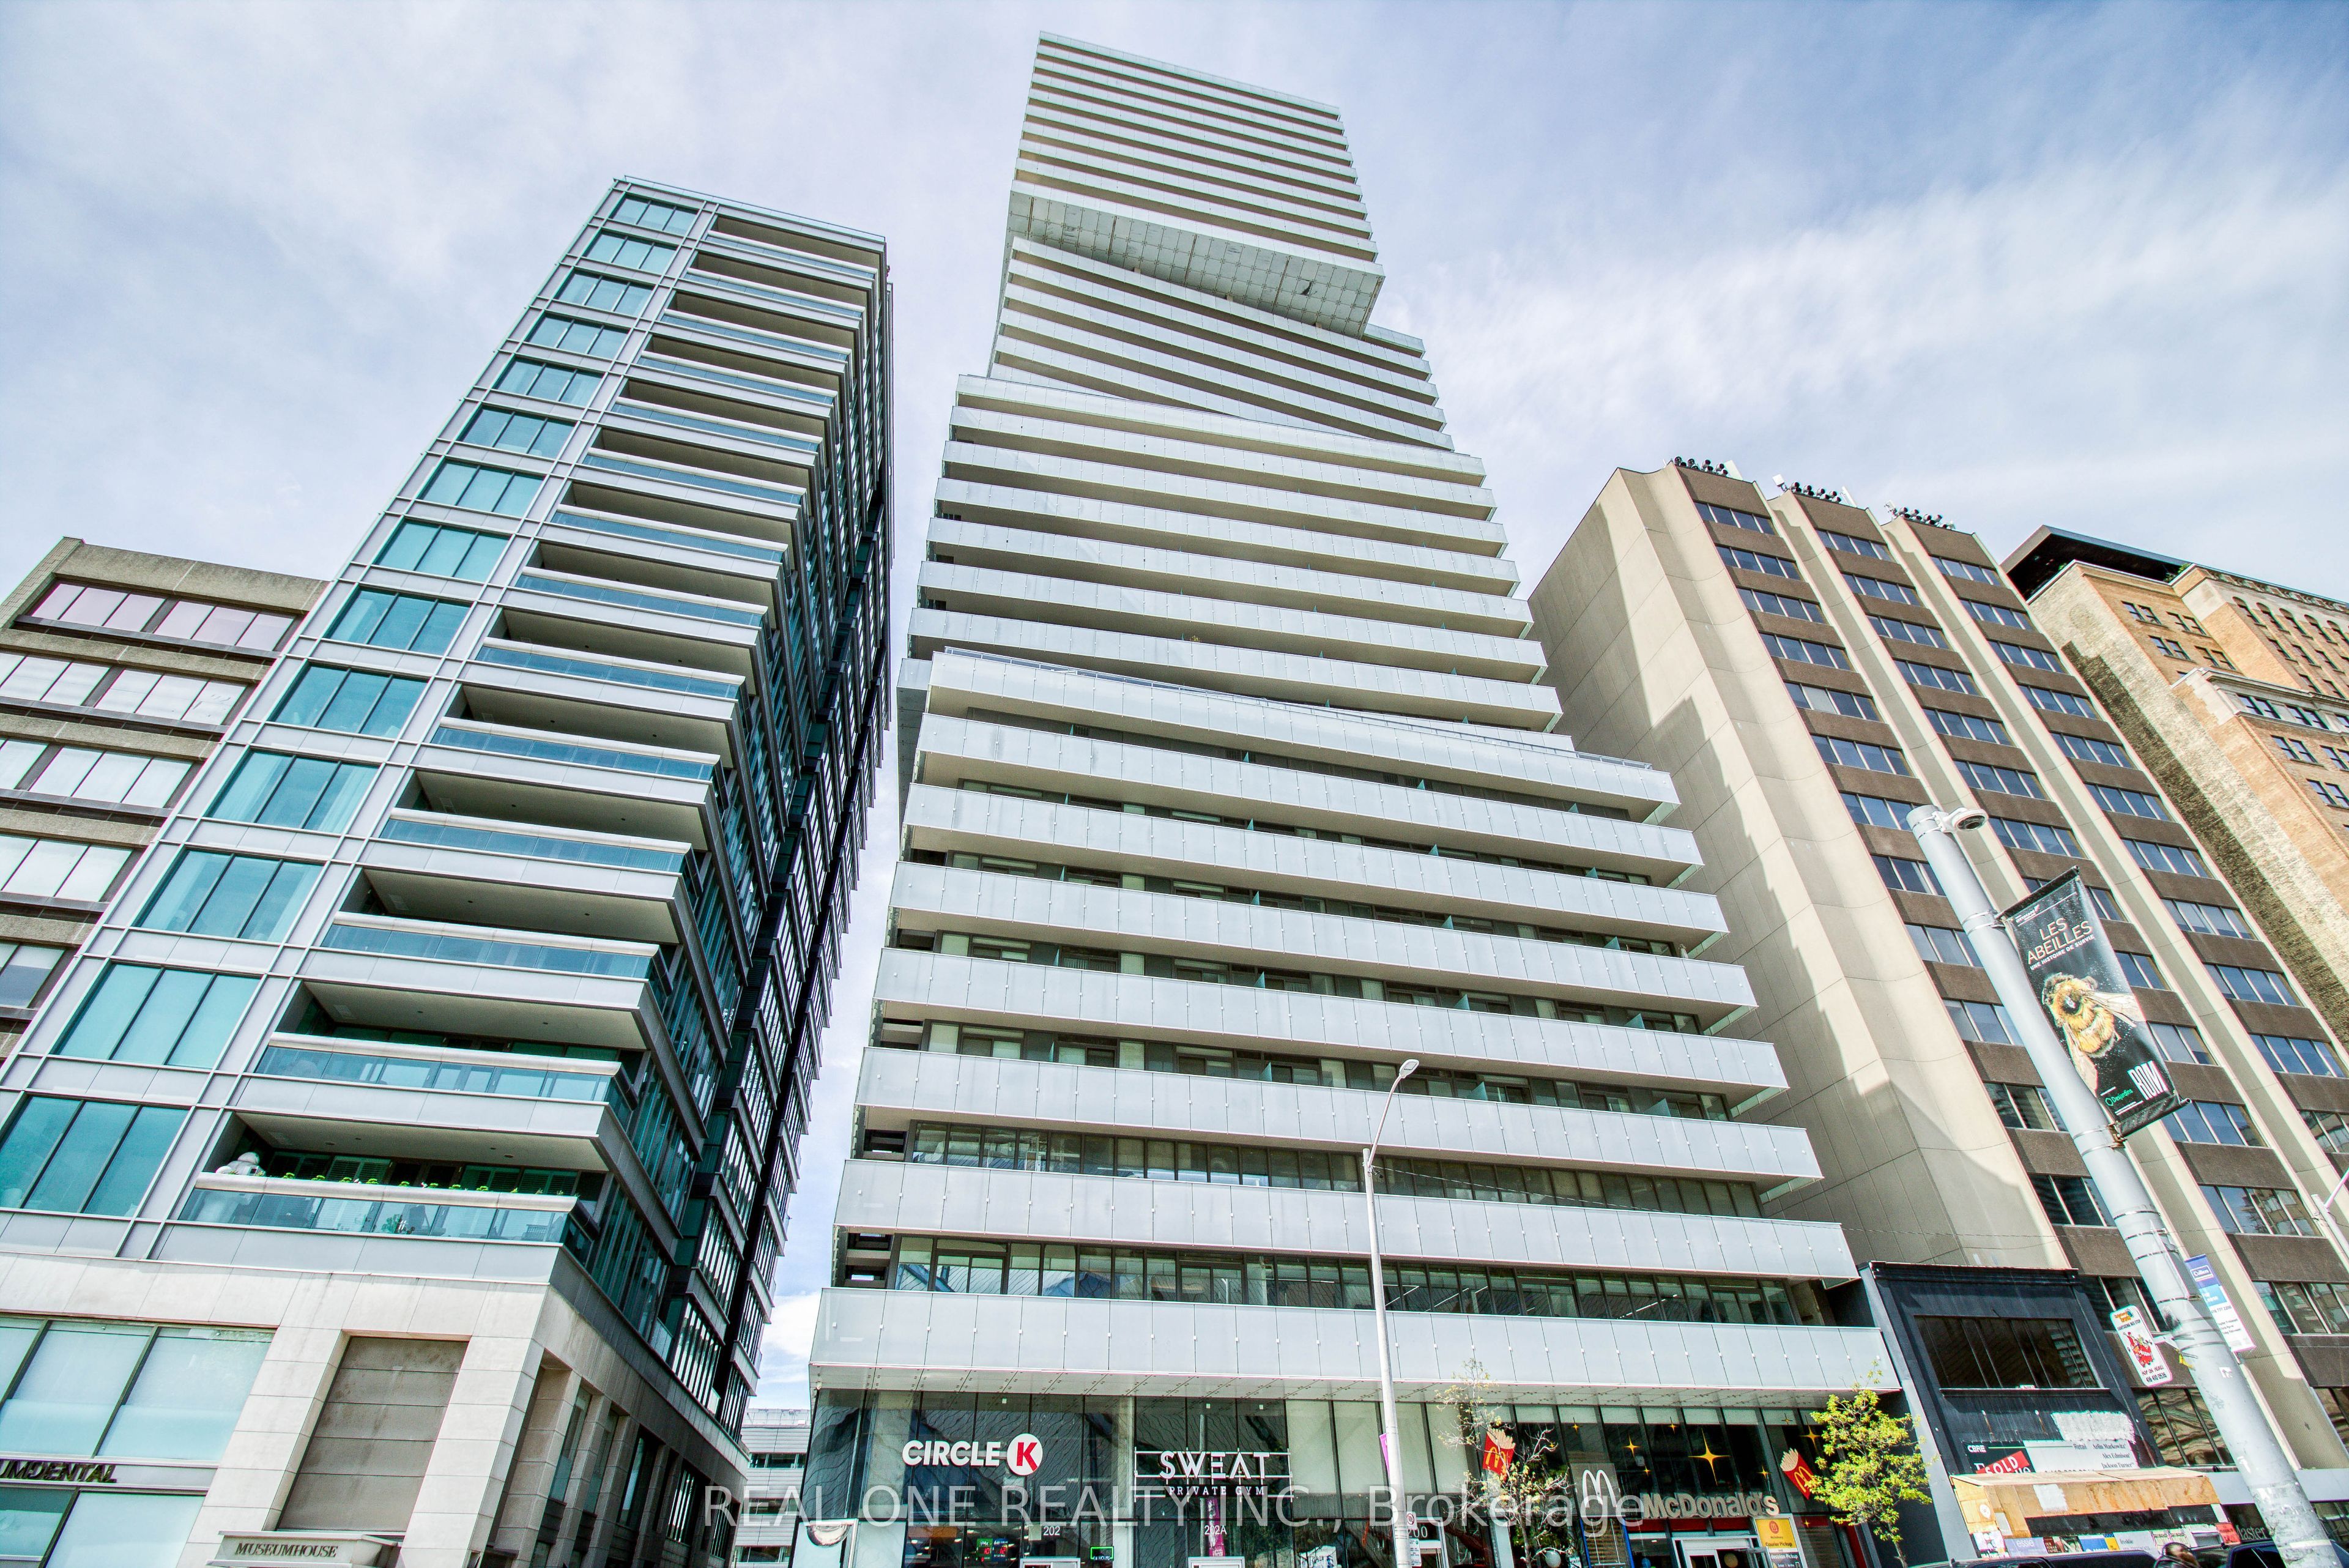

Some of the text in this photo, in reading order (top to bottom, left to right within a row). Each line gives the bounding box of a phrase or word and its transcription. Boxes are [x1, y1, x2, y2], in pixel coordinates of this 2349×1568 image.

[2027, 920, 2093, 965] ABEILLES
[2039, 918, 2068, 940] LES
[2030, 961, 2041, 970] UNE
[2041, 949, 2066, 965] HISTOIRE
[2074, 934, 2095, 948] SURVIE
[2127, 1060, 2169, 1101] ROM
[2111, 1089, 2133, 1103] Desjardins
[902, 1440, 1038, 1471] CIRCLE K
[1160, 1450, 1270, 1480] SWEAT
[1168, 1486, 1264, 1496] PRIVATE GYM
[1641, 1490, 1780, 1519] McDonald's
[1043, 1526, 1061, 1536] 202
[1204, 1525, 1227, 1535] 202A
